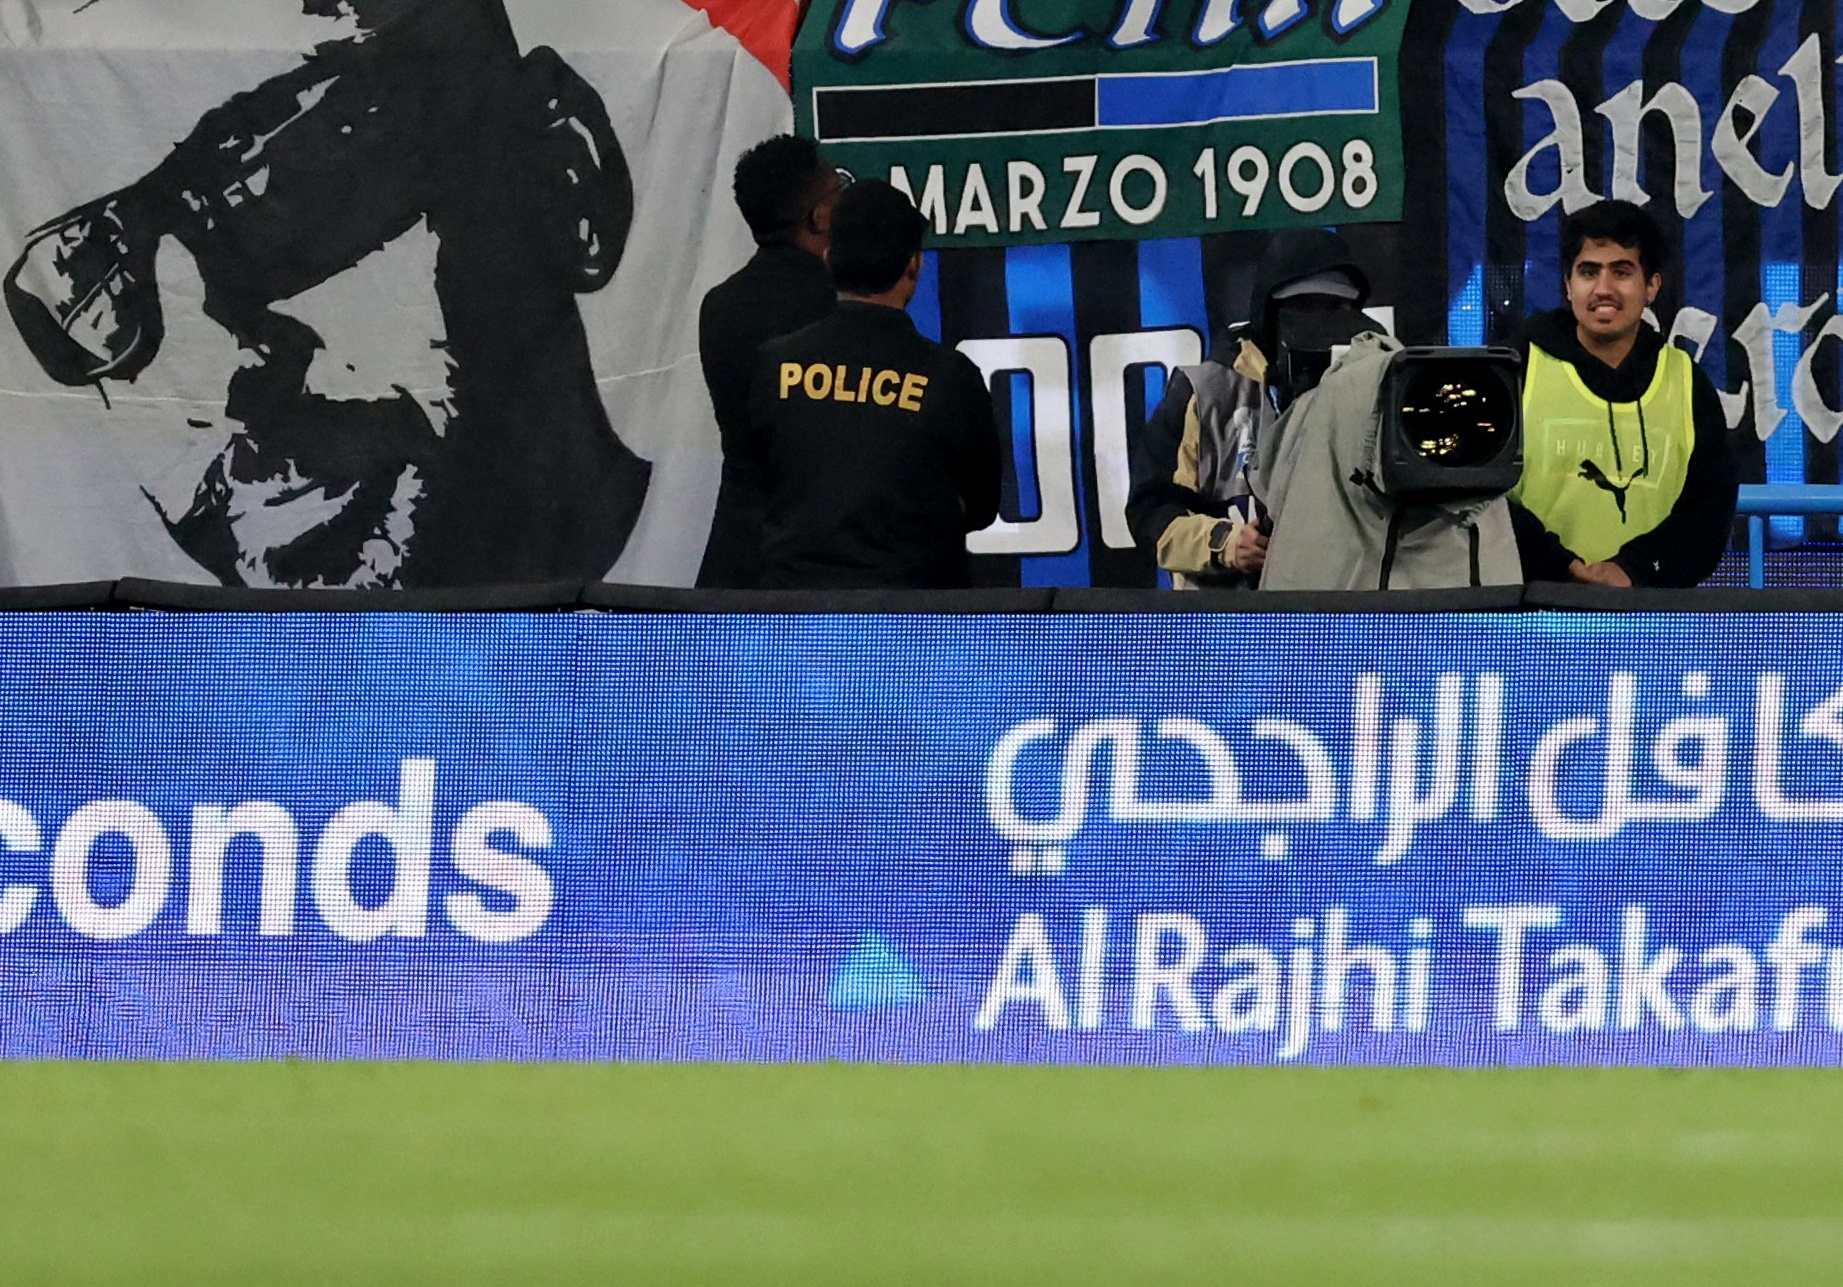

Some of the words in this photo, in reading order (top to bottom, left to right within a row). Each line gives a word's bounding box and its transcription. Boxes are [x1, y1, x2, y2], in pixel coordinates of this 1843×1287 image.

[888, 154, 1168, 237] MARZO
[1193, 139, 1379, 220] 1908
[778, 361, 929, 412] POLICE
[983, 669, 1507, 875] الراجحي
